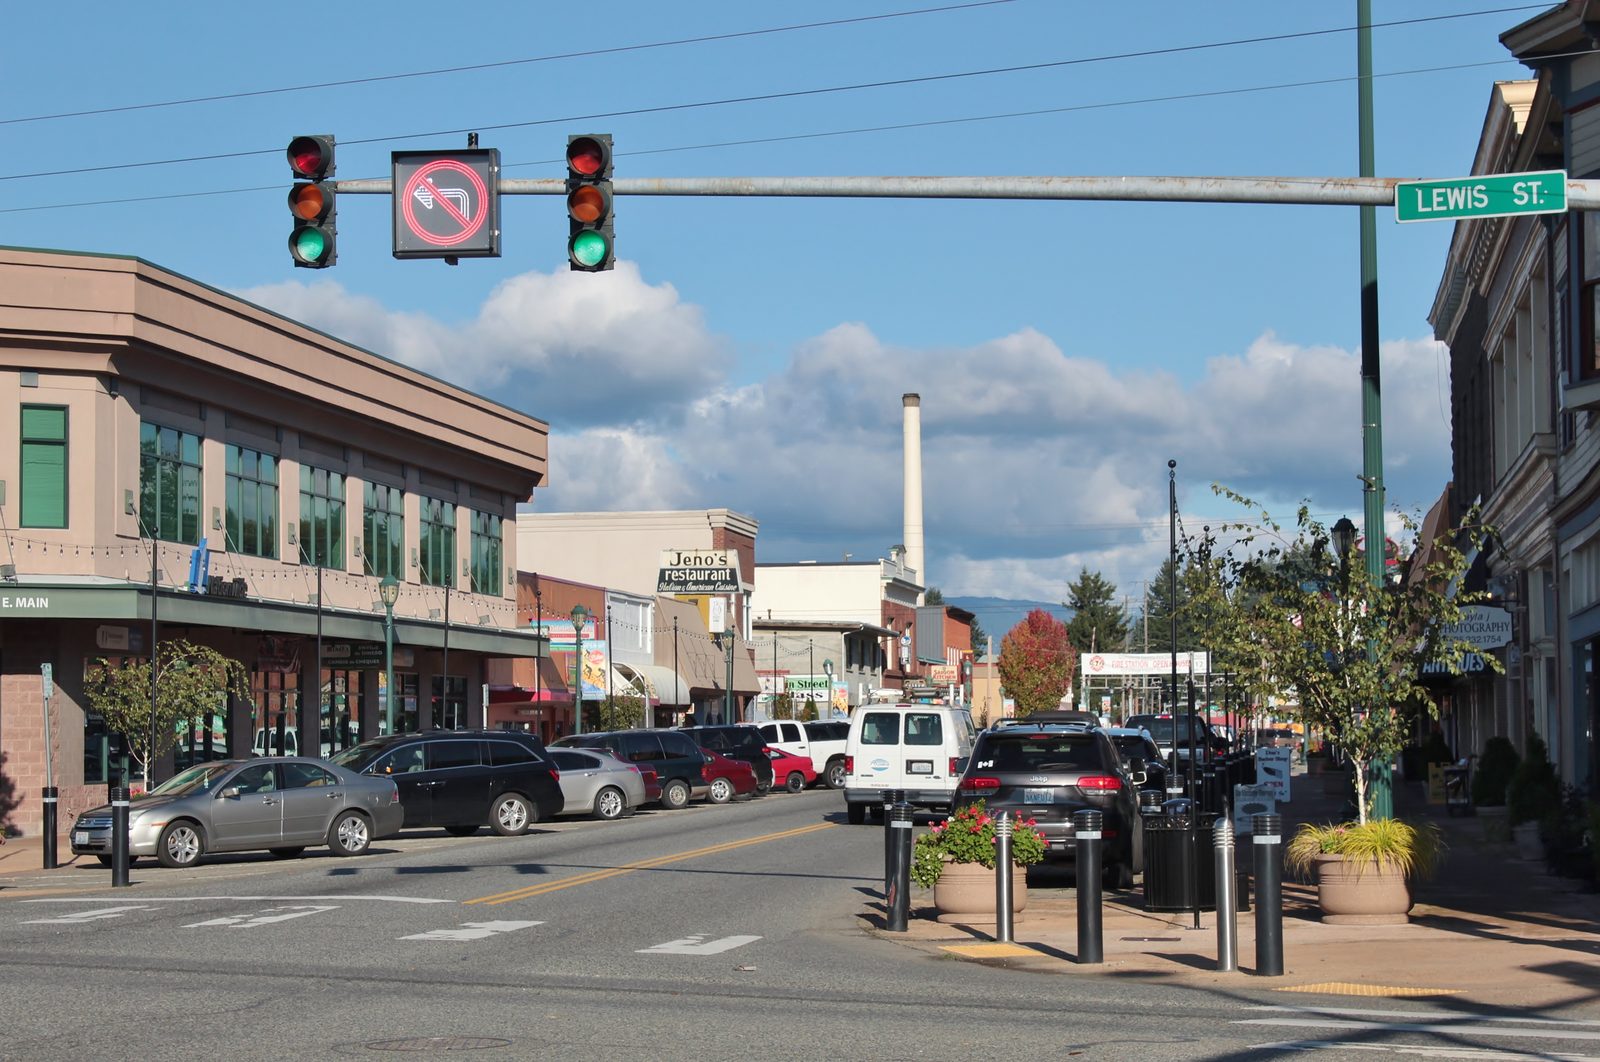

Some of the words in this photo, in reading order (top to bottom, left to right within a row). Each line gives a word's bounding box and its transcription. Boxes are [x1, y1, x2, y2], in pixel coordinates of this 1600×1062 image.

[1416, 184, 1488, 212] LEWIS
[1513, 181, 1544, 206] ST.
[669, 552, 728, 567] Jeno's
[665, 568, 731, 581] restaurant
[686, 582, 714, 591] American
[714, 581, 737, 591] Cuisine
[2, 597, 13, 608] E.
[15, 597, 49, 608] MAIN
[797, 679, 828, 689] Street
[790, 691, 824, 699] lass
[1029, 775, 1048, 784] Jeep
